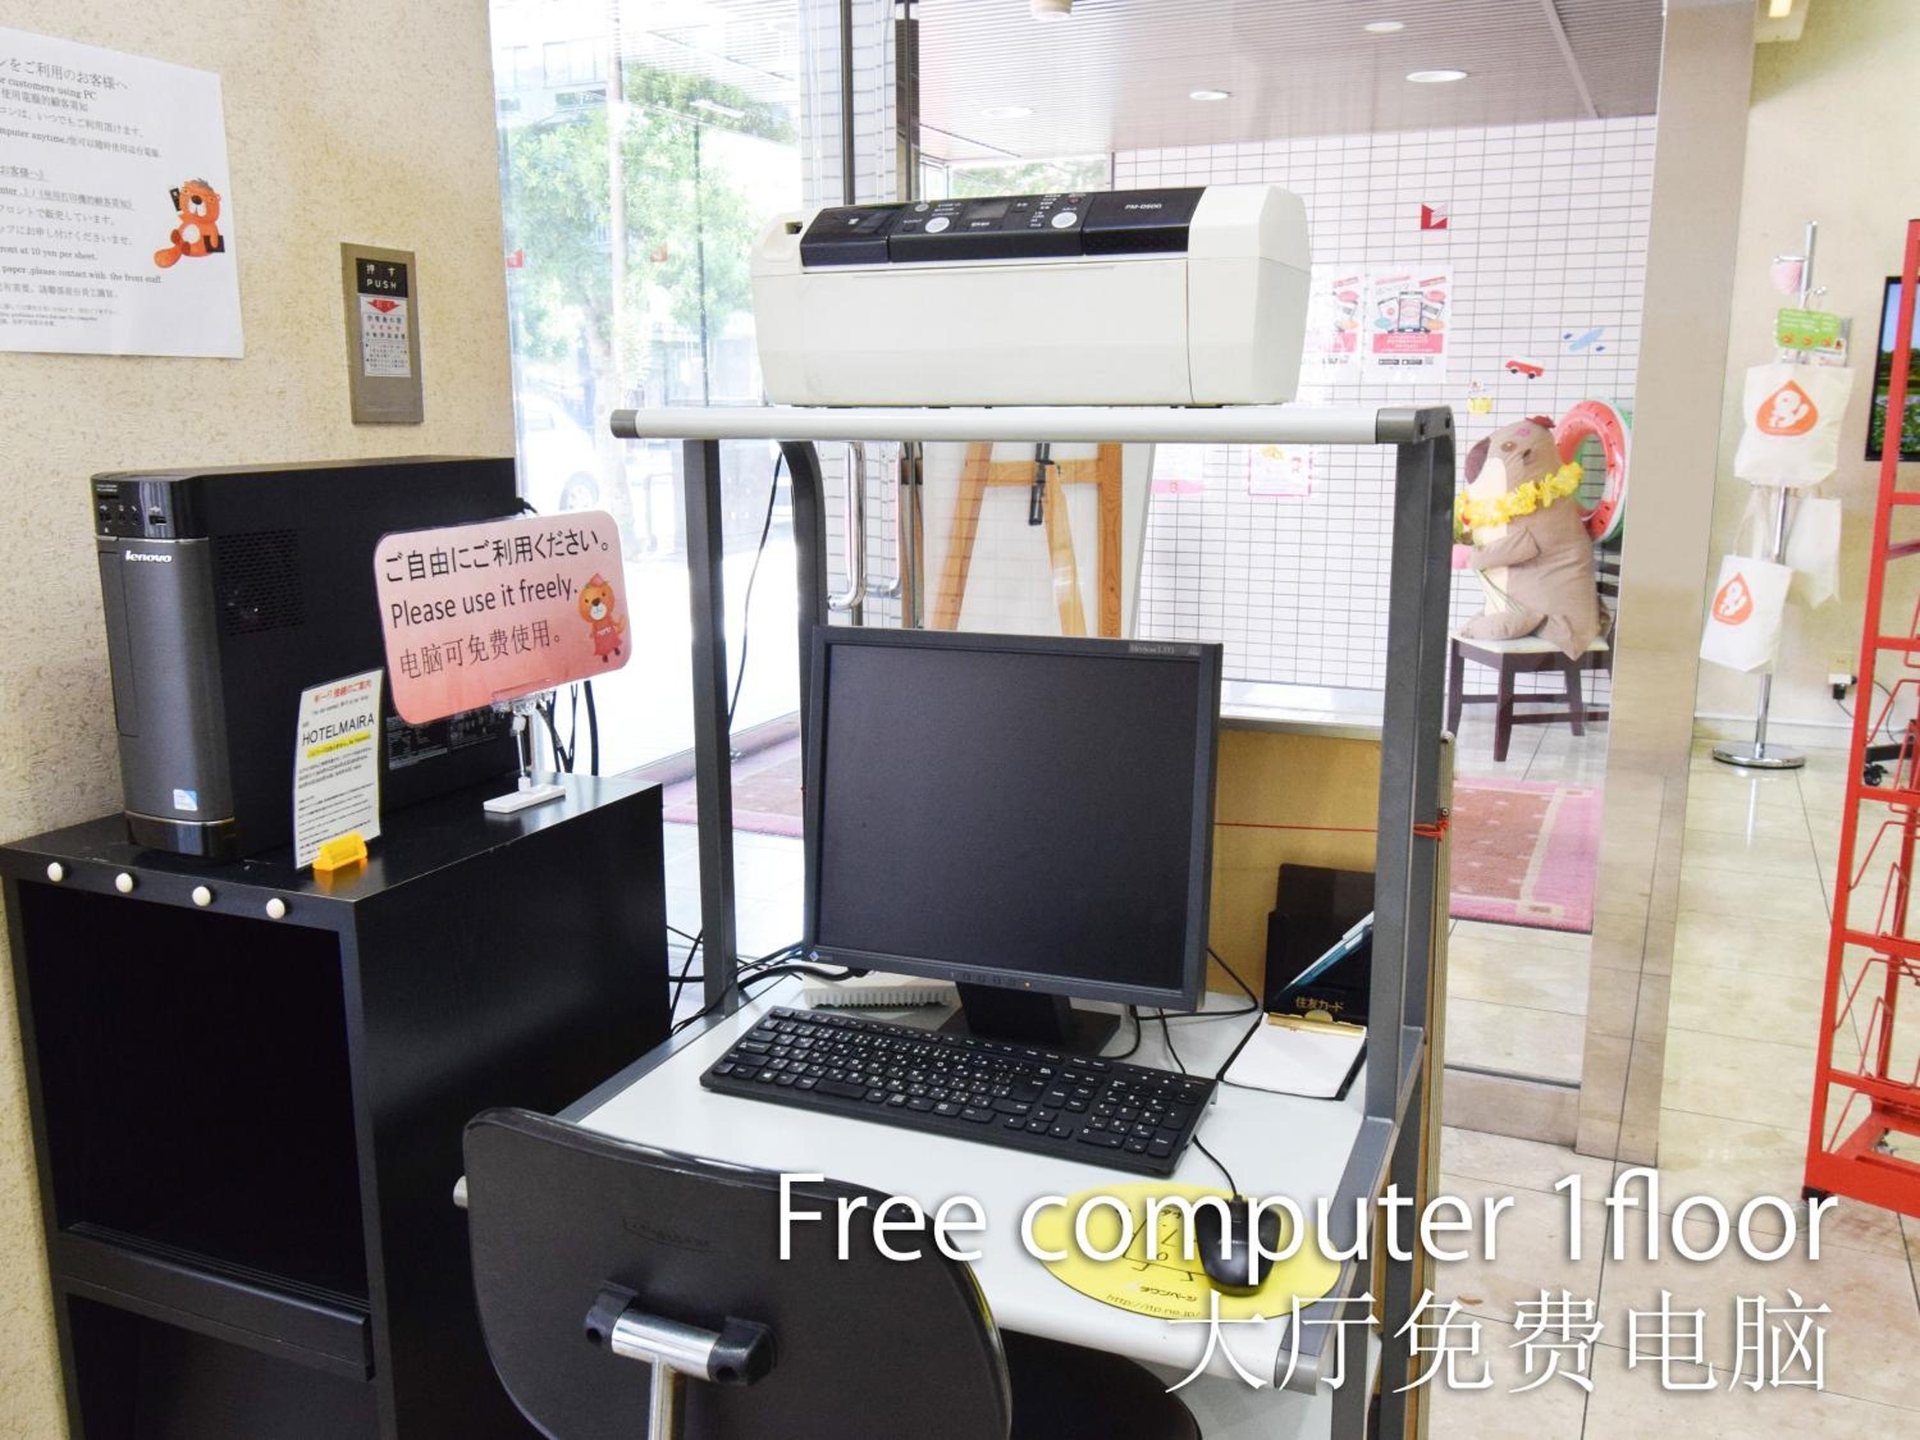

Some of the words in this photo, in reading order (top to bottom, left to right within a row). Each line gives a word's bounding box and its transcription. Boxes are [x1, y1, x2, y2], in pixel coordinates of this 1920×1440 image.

[8, 79, 55, 93] customers
[57, 88, 81, 99] using
[83, 90, 97, 99] PC
[31, 248, 41, 256] 10
[58, 268, 86, 279] contact
[366, 280, 397, 290] PUSH
[125, 549, 172, 563] lenovo
[386, 528, 608, 583] ご自由にご利用ください。
[391, 597, 456, 629] Please
[462, 591, 496, 615] use
[501, 583, 516, 607] it
[520, 572, 579, 606] freely.
[400, 618, 560, 680] 电脑可免费使用。
